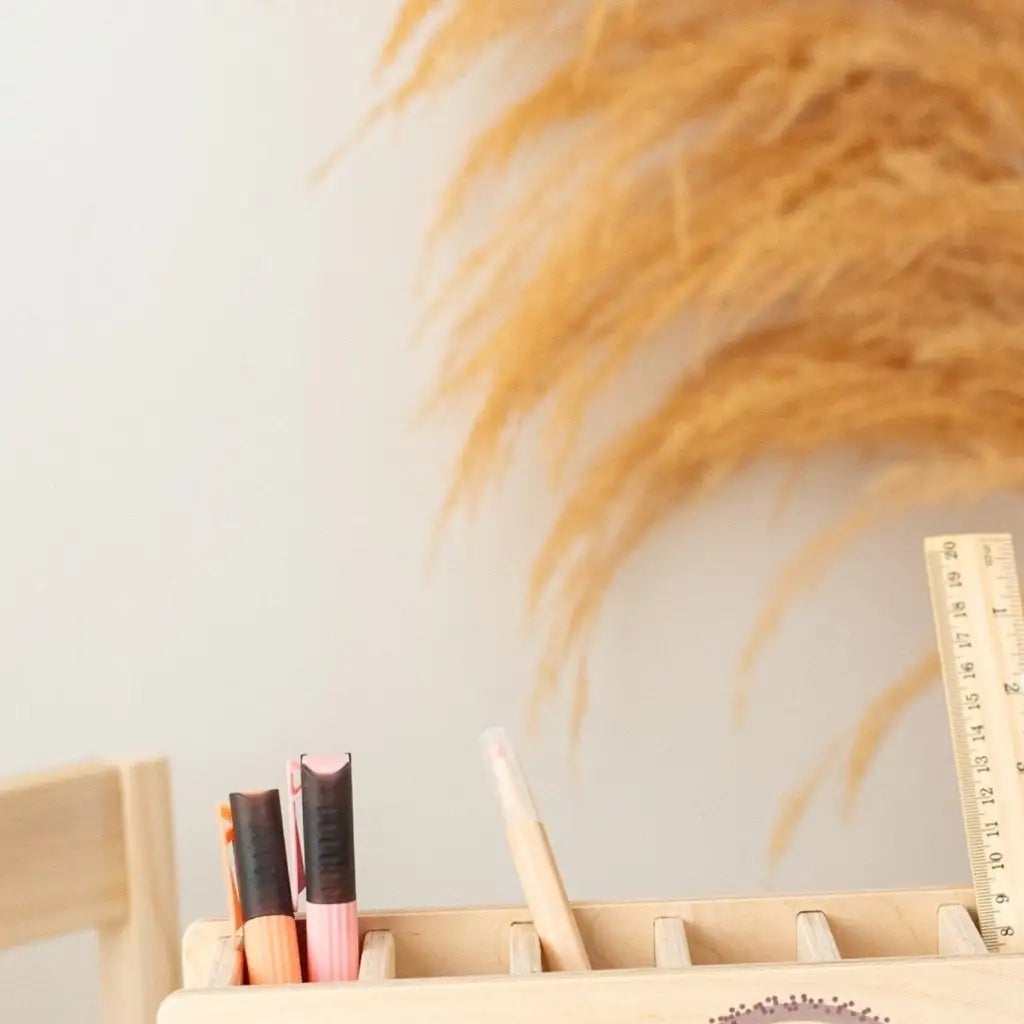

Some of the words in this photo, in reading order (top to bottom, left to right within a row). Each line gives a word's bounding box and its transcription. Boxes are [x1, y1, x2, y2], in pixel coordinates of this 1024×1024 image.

[943, 541, 958, 560] 20
[948, 572, 962, 588] 19
[952, 601, 967, 618] 18
[992, 607, 1007, 615] 1
[957, 633, 972, 649] 17
[961, 662, 976, 680] 16
[1005, 682, 1020, 695] 2
[966, 693, 981, 711] 15
[971, 724, 986, 741] 14
[975, 755, 990, 774] 13
[980, 787, 995, 805] 12
[985, 821, 1000, 838] 11
[989, 852, 1004, 870] 10
[995, 893, 1009, 904] 9
[1000, 925, 1014, 937] 8
